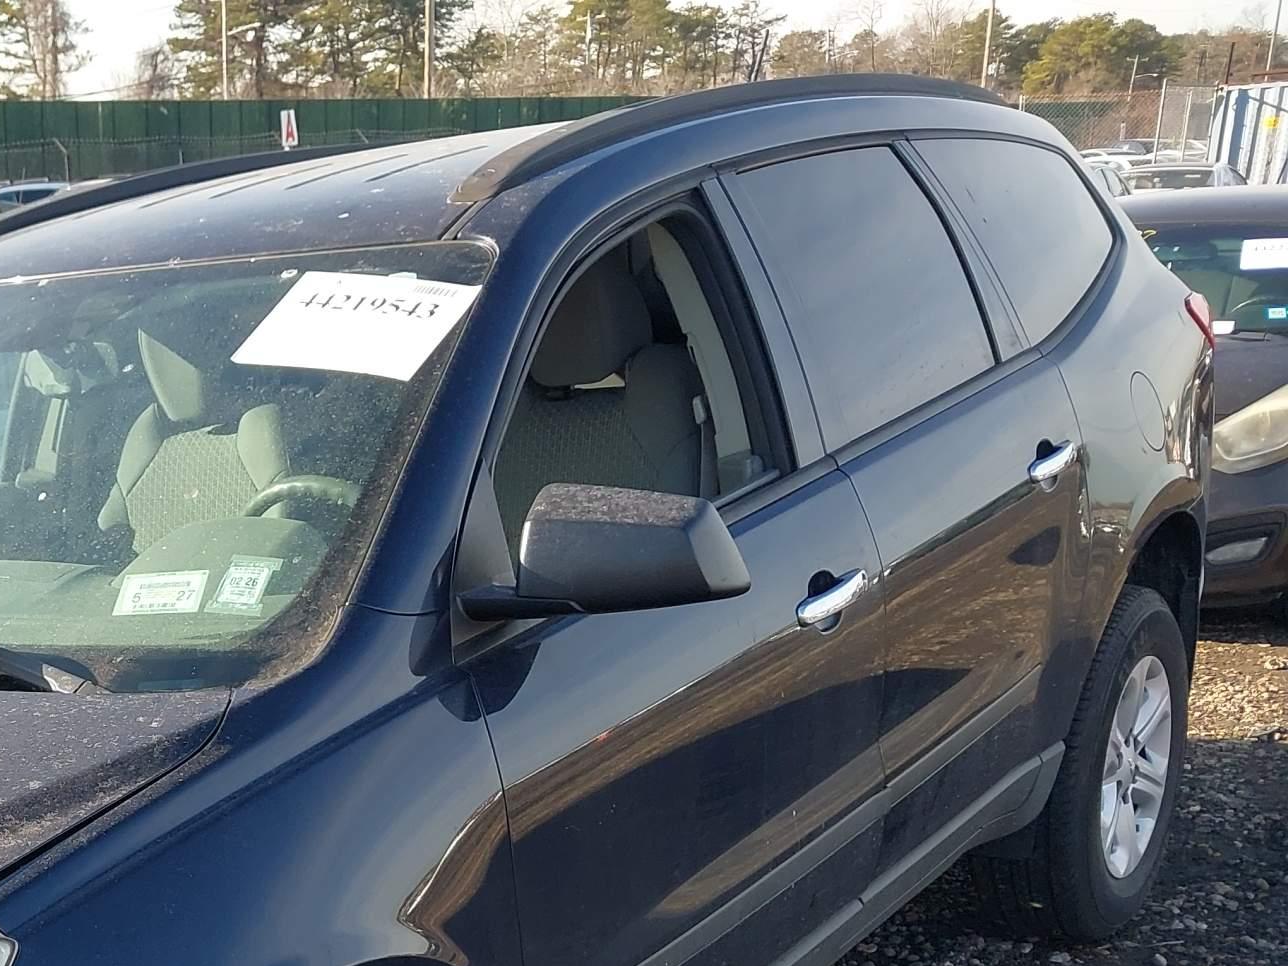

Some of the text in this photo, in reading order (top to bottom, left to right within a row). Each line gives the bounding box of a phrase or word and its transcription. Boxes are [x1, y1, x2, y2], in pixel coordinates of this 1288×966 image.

[286, 111, 295, 143] A
[299, 292, 440, 318] 44219543
[131, 589, 196, 604] 5 27
